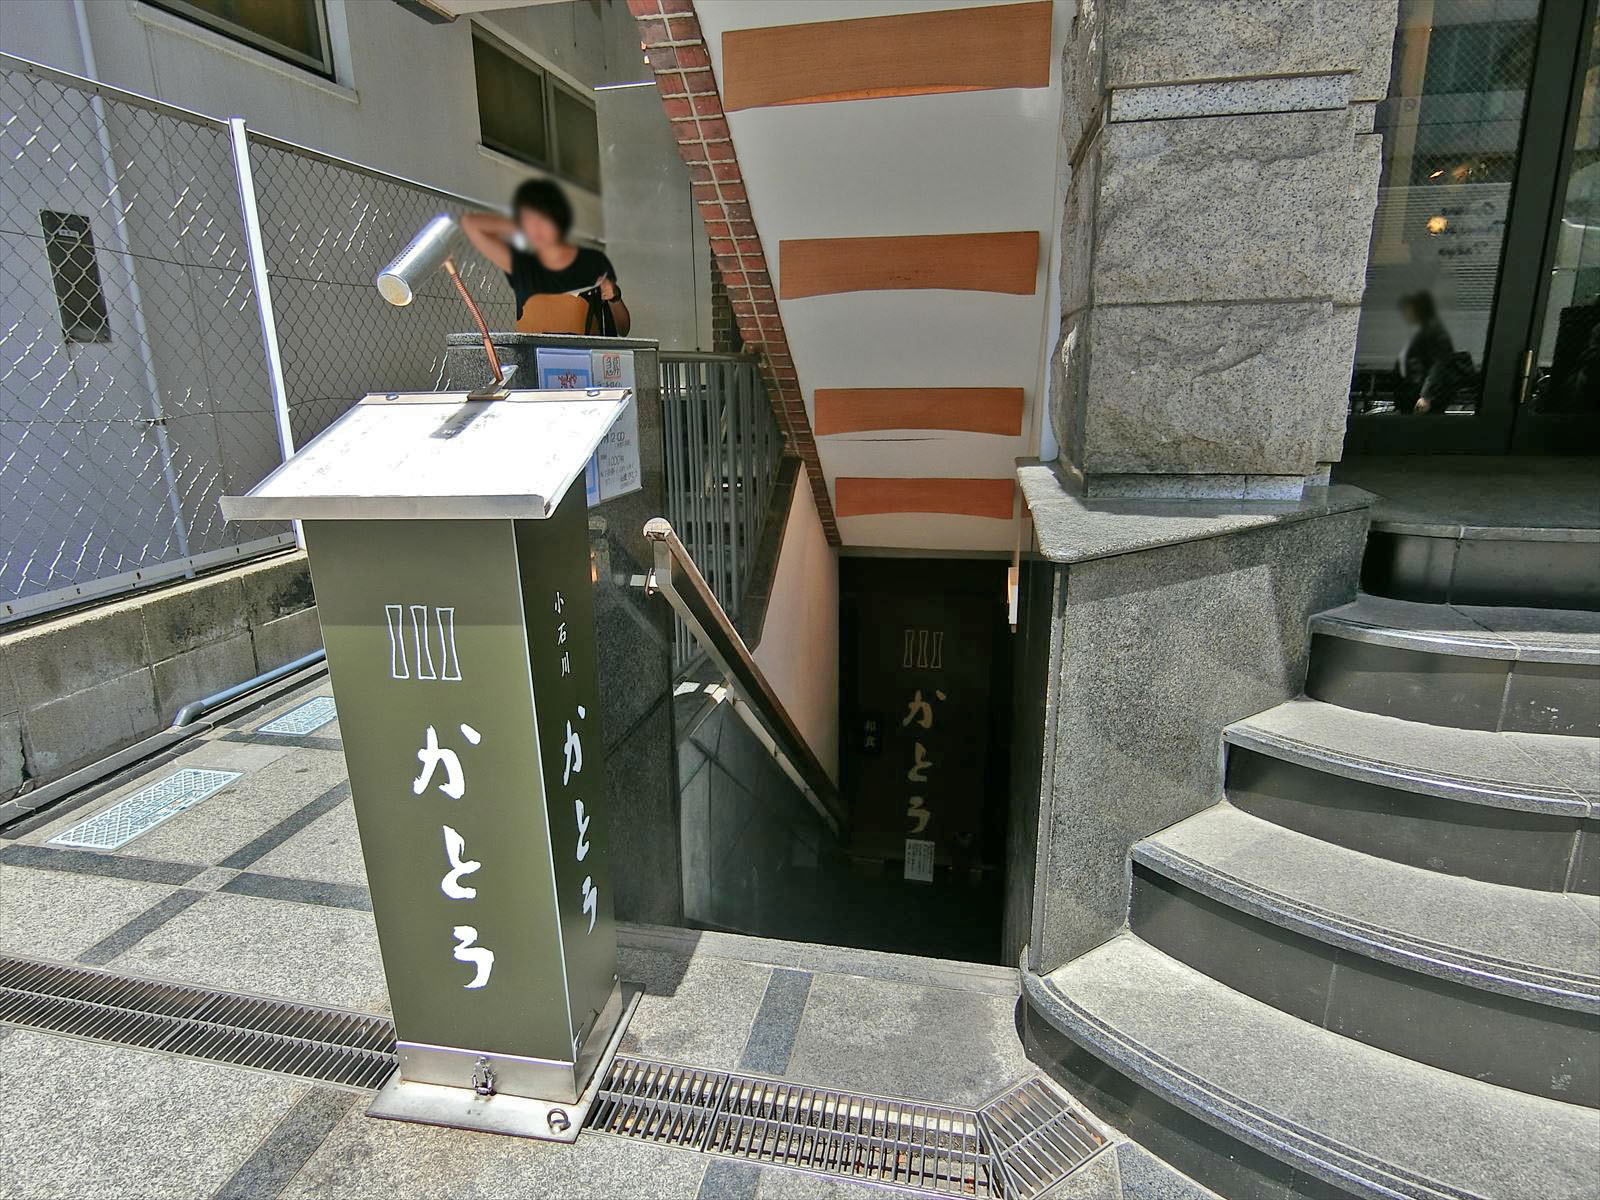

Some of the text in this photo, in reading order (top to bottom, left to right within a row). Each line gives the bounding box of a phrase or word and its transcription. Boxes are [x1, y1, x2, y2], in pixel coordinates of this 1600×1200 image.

[553, 591, 571, 678] 小石川
[413, 722, 495, 989] かとう
[563, 704, 598, 936] かとう
[902, 689, 947, 834] かとう
